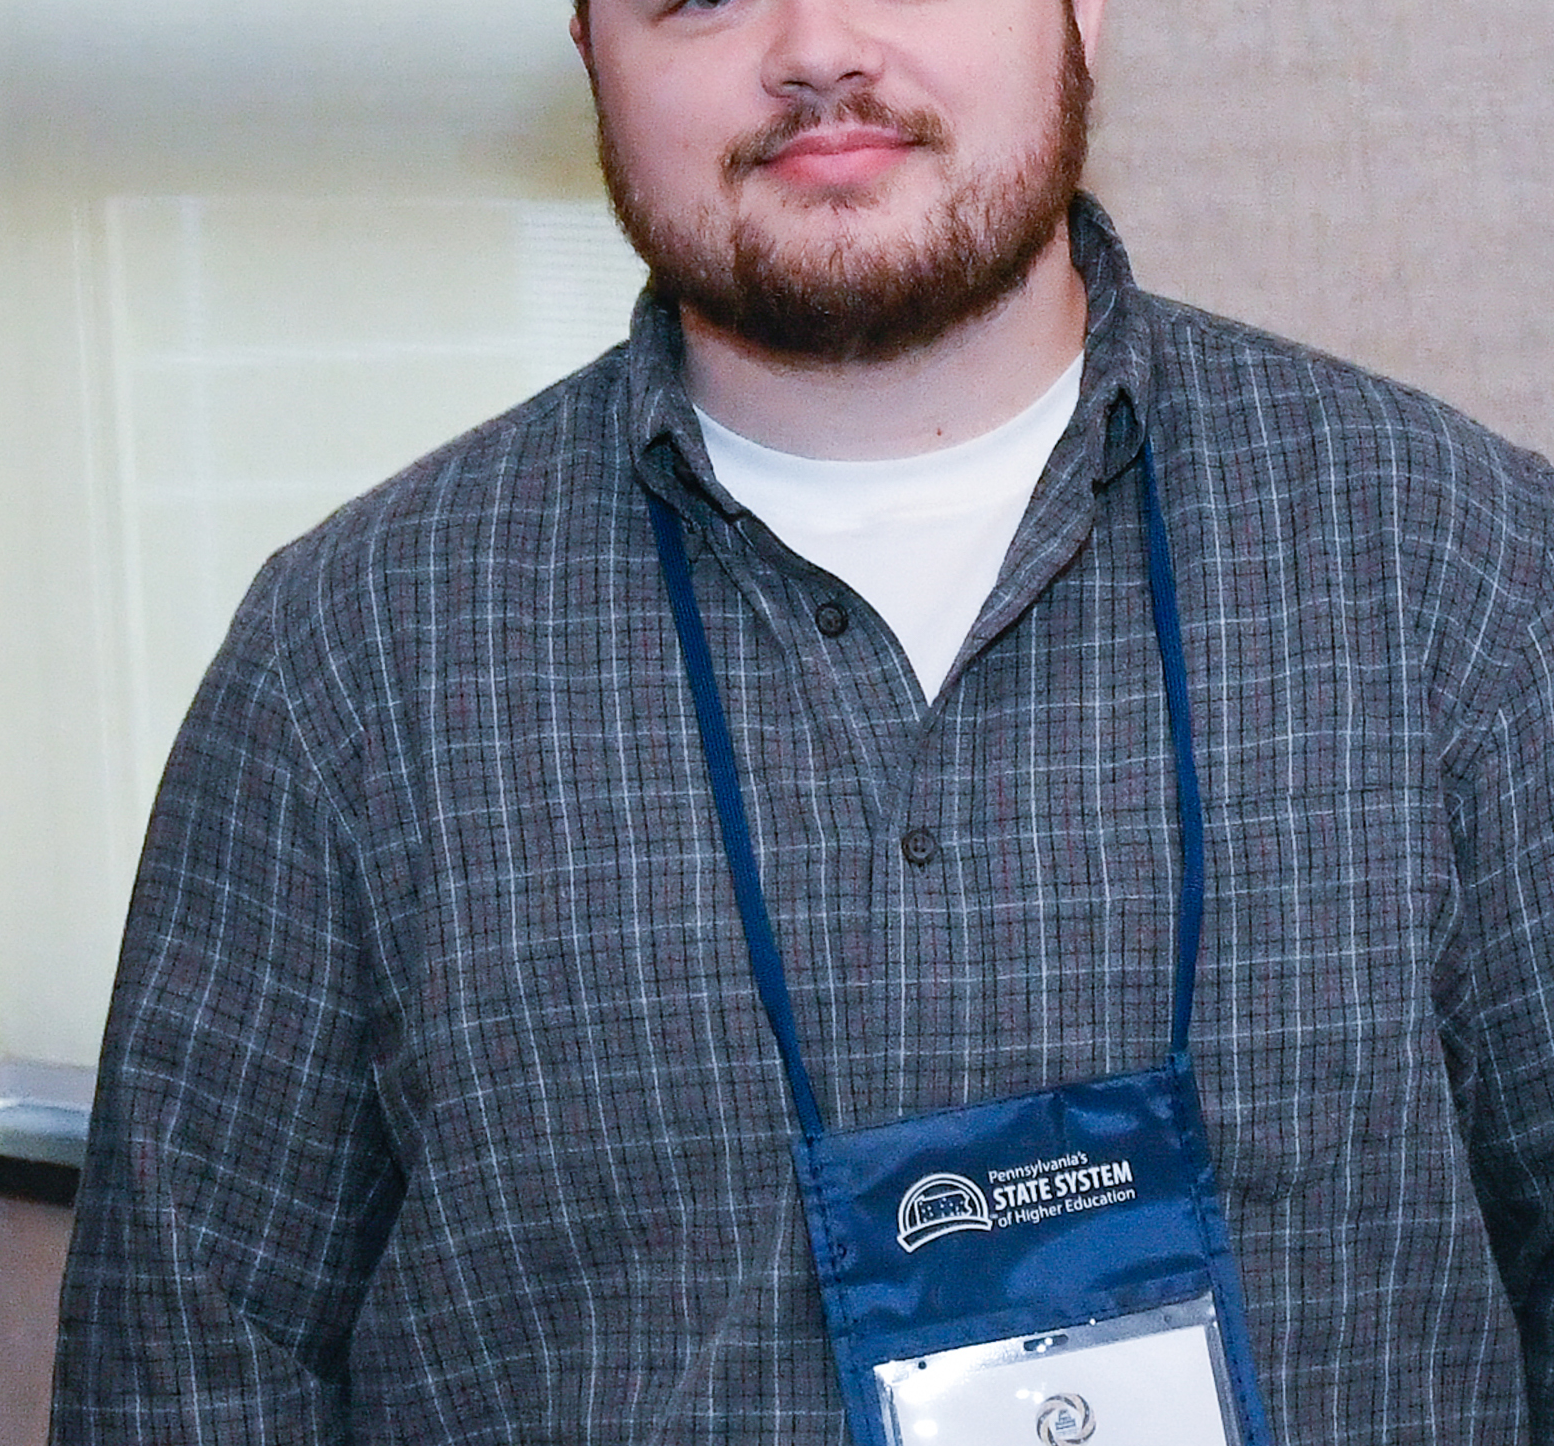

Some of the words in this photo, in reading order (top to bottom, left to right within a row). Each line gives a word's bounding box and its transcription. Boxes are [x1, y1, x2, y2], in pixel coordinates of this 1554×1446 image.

[988, 1151, 1088, 1184] Pennsylvania's
[993, 1178, 1052, 1210] STATE
[1055, 1160, 1133, 1197] SYSTEM
[998, 1209, 1014, 1229] of
[1015, 1204, 1062, 1224] Higher
[1065, 1189, 1135, 1212] Education
